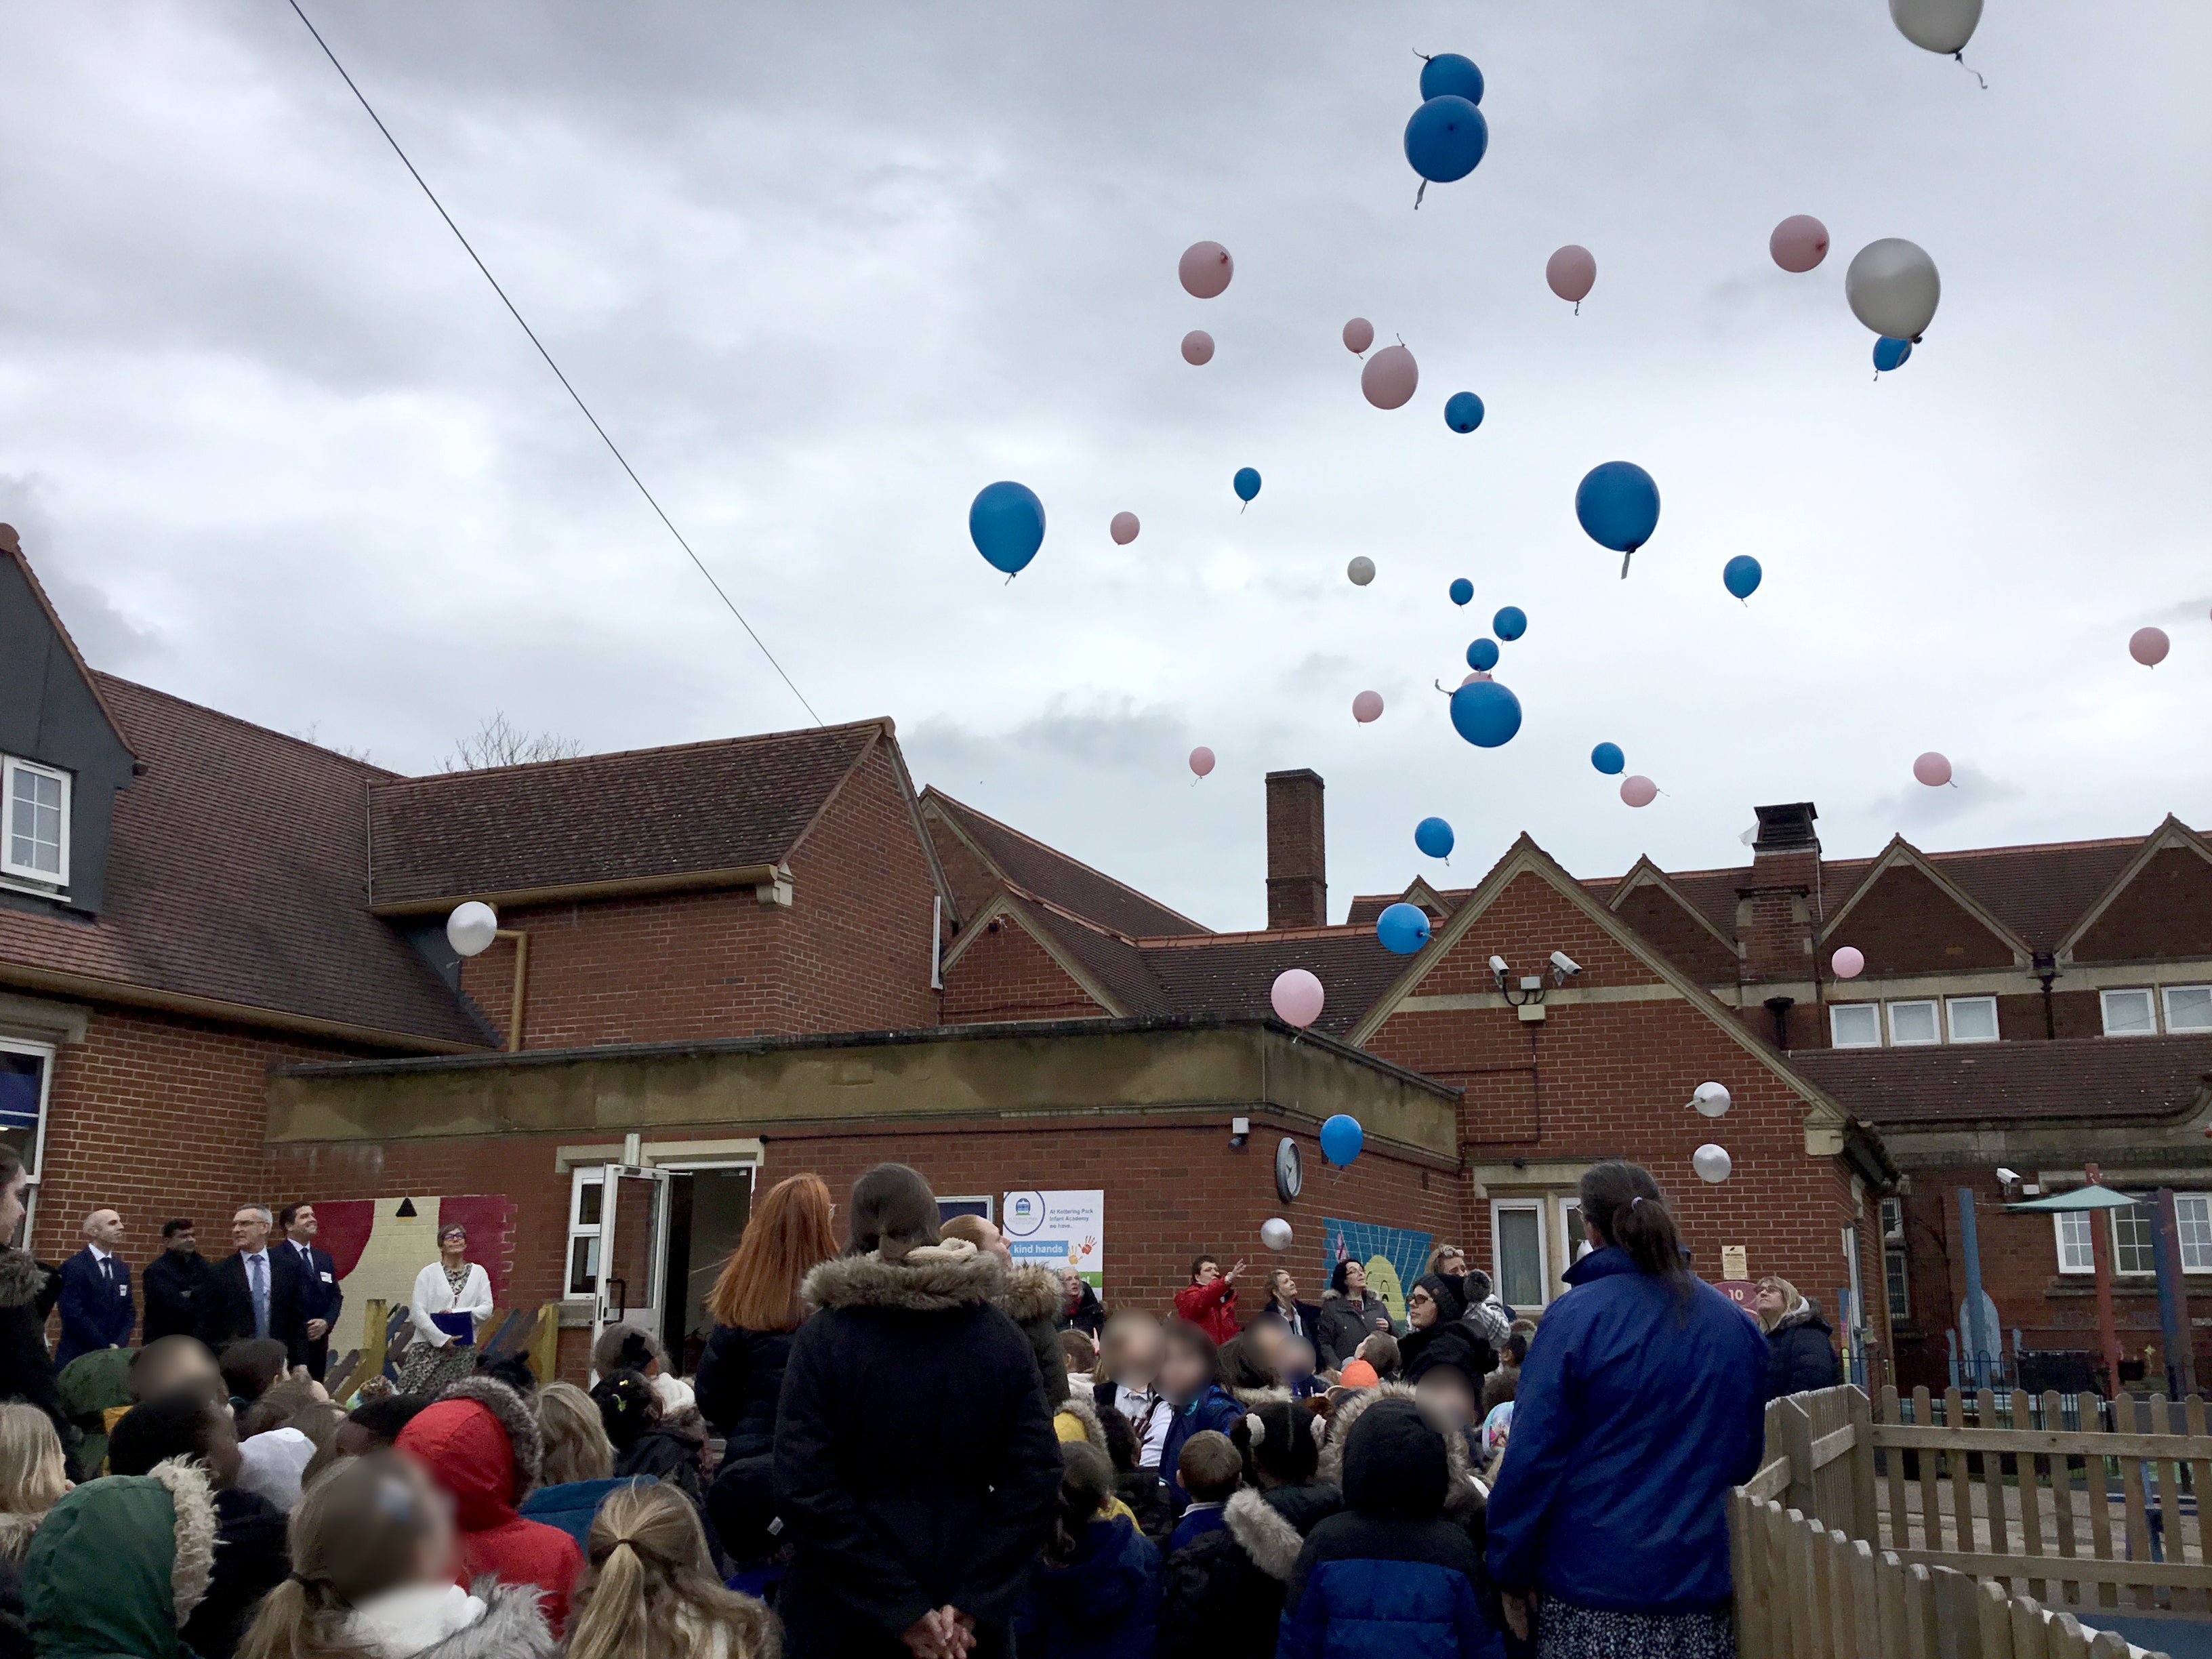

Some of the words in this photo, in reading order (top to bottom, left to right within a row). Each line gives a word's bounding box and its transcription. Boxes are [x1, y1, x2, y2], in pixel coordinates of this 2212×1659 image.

[1014, 1244, 1033, 1254] kind
[1036, 1244, 1063, 1254] hands
[1728, 1288, 1744, 1300] 10
